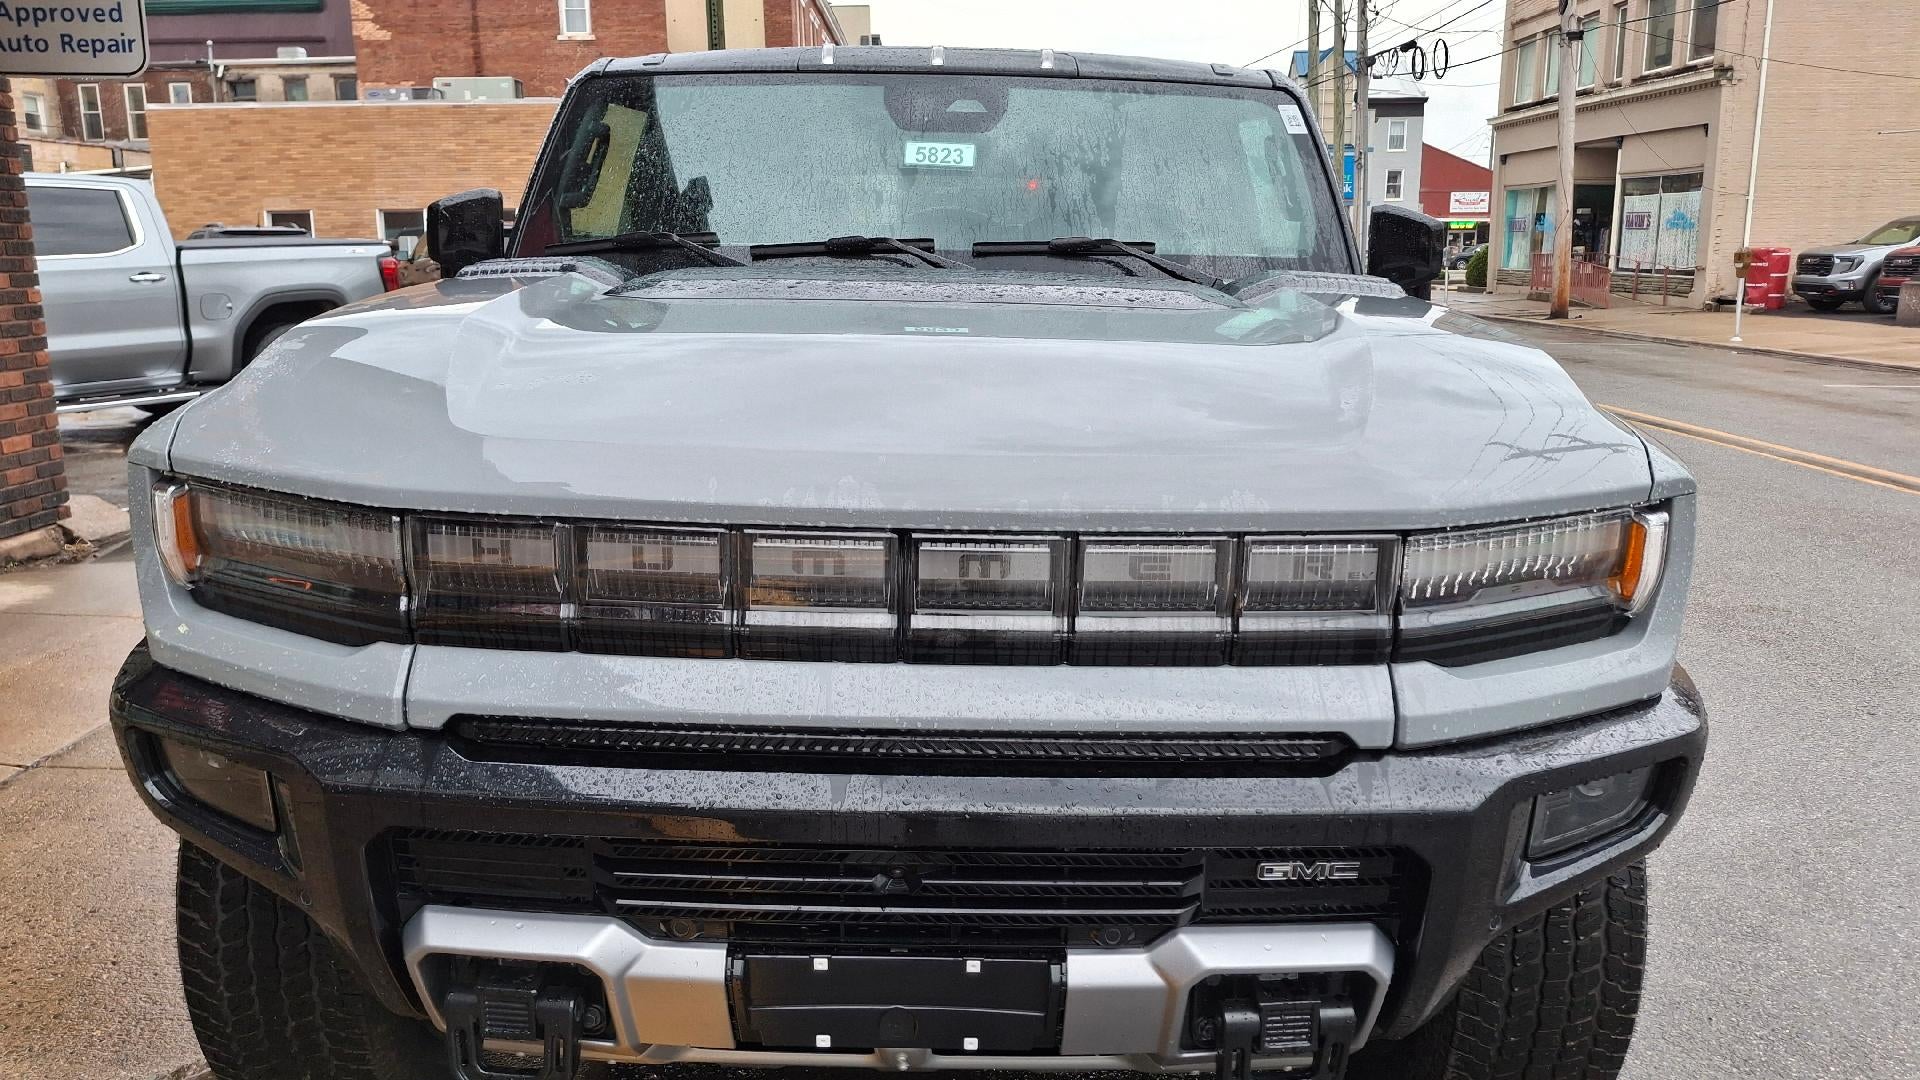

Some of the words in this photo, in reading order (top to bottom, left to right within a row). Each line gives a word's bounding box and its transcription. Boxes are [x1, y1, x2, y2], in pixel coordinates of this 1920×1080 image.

[0, 1, 123, 27] Approved
[59, 32, 136, 58] Repair
[915, 146, 964, 165] 5823
[1257, 861, 1361, 881] GMC
